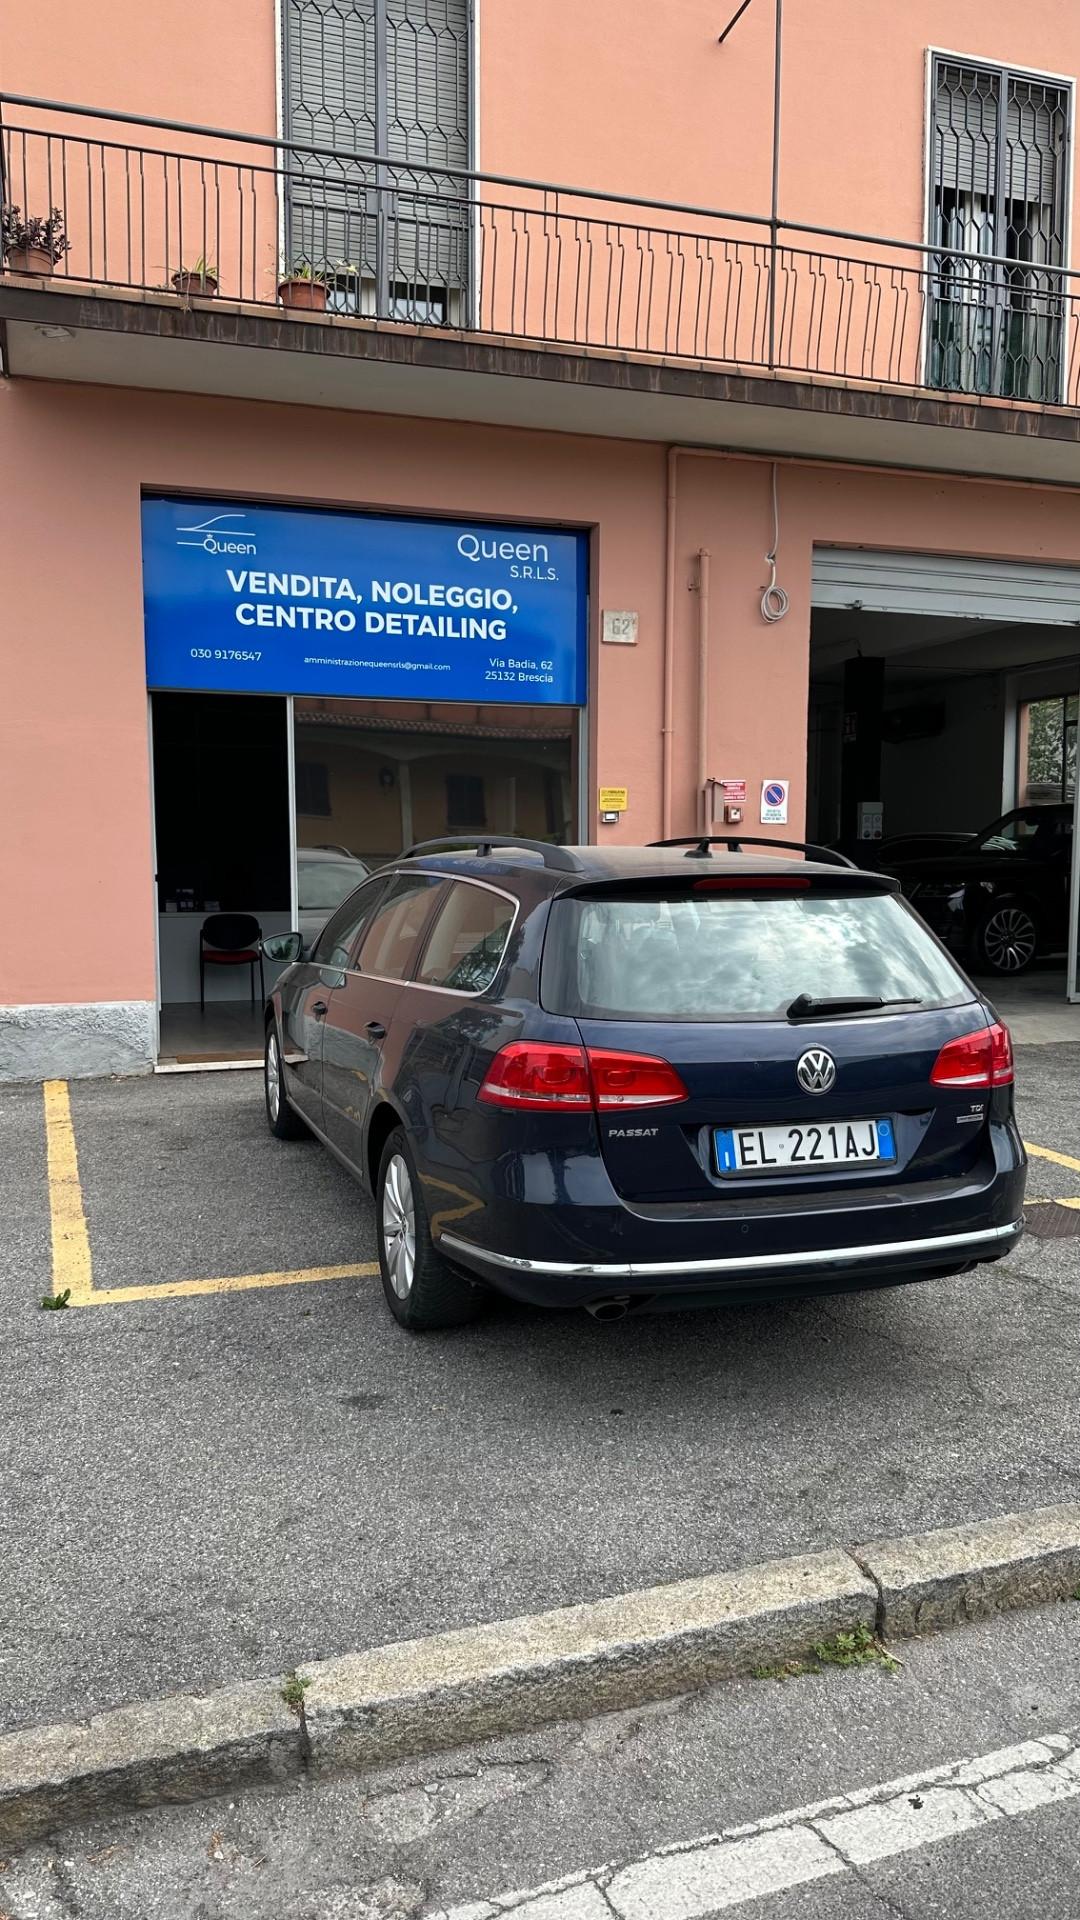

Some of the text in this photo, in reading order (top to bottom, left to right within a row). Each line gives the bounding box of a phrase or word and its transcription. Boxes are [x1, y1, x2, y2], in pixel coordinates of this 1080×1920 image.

[203, 538, 257, 556] Queen
[457, 534, 549, 563] Queen
[510, 565, 559, 581] S.R.L.S.
[226, 569, 518, 614] VENDITA, NOLEGGIO,
[235, 603, 507, 641] CENTRO DETAILING
[190, 648, 262, 662] 030 9176547
[304, 655, 451, 672] amministrazionequeensrls@gmail.com
[489, 657, 553, 671] Via Badia, 62
[485, 670, 554, 683] 25132 Brescia
[608, 1127, 659, 1138] PASSAT
[738, 1131, 777, 1166] EL
[788, 1123, 877, 1163] 221AJ
